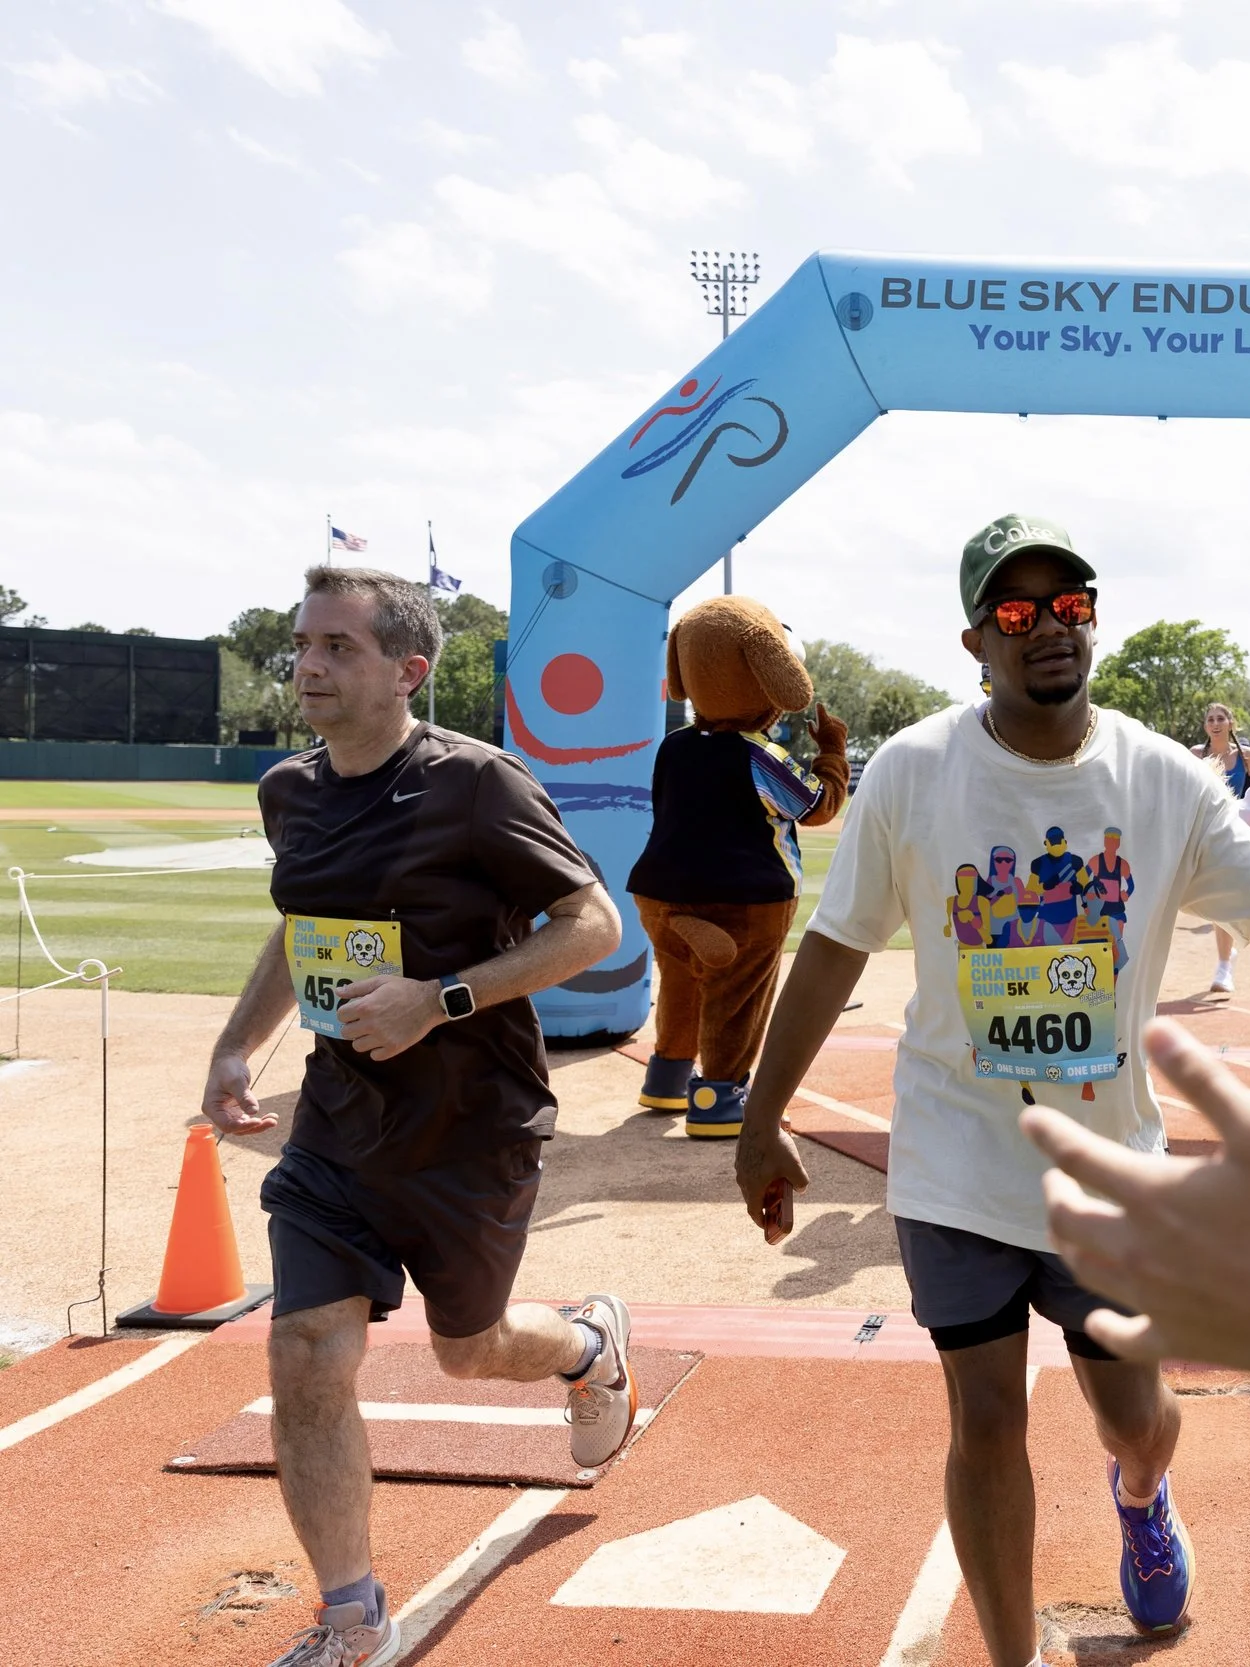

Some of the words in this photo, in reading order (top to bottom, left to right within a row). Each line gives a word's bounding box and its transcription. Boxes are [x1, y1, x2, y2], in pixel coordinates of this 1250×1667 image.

[880, 277, 1008, 311] BLUE
[1018, 281, 1122, 313] SKY
[968, 324, 1051, 352] Your
[1060, 326, 1133, 357] Sky.
[1141, 328, 1224, 355] Your
[294, 919, 316, 933] RUN
[293, 933, 341, 948] CHARLIE
[293, 945, 316, 958] RUN
[317, 947, 333, 961] 5K
[971, 954, 1003, 967] RUN
[971, 966, 1041, 981] CHARLIE
[972, 983, 1005, 996] RUN
[1007, 982, 1030, 996] 5K
[988, 1012, 1092, 1054] 4460
[996, 1063, 1014, 1074] ONE
[1014, 1066, 1037, 1077] BEER
[1067, 1065, 1089, 1077] ONE
[1090, 1063, 1115, 1074] BEER
